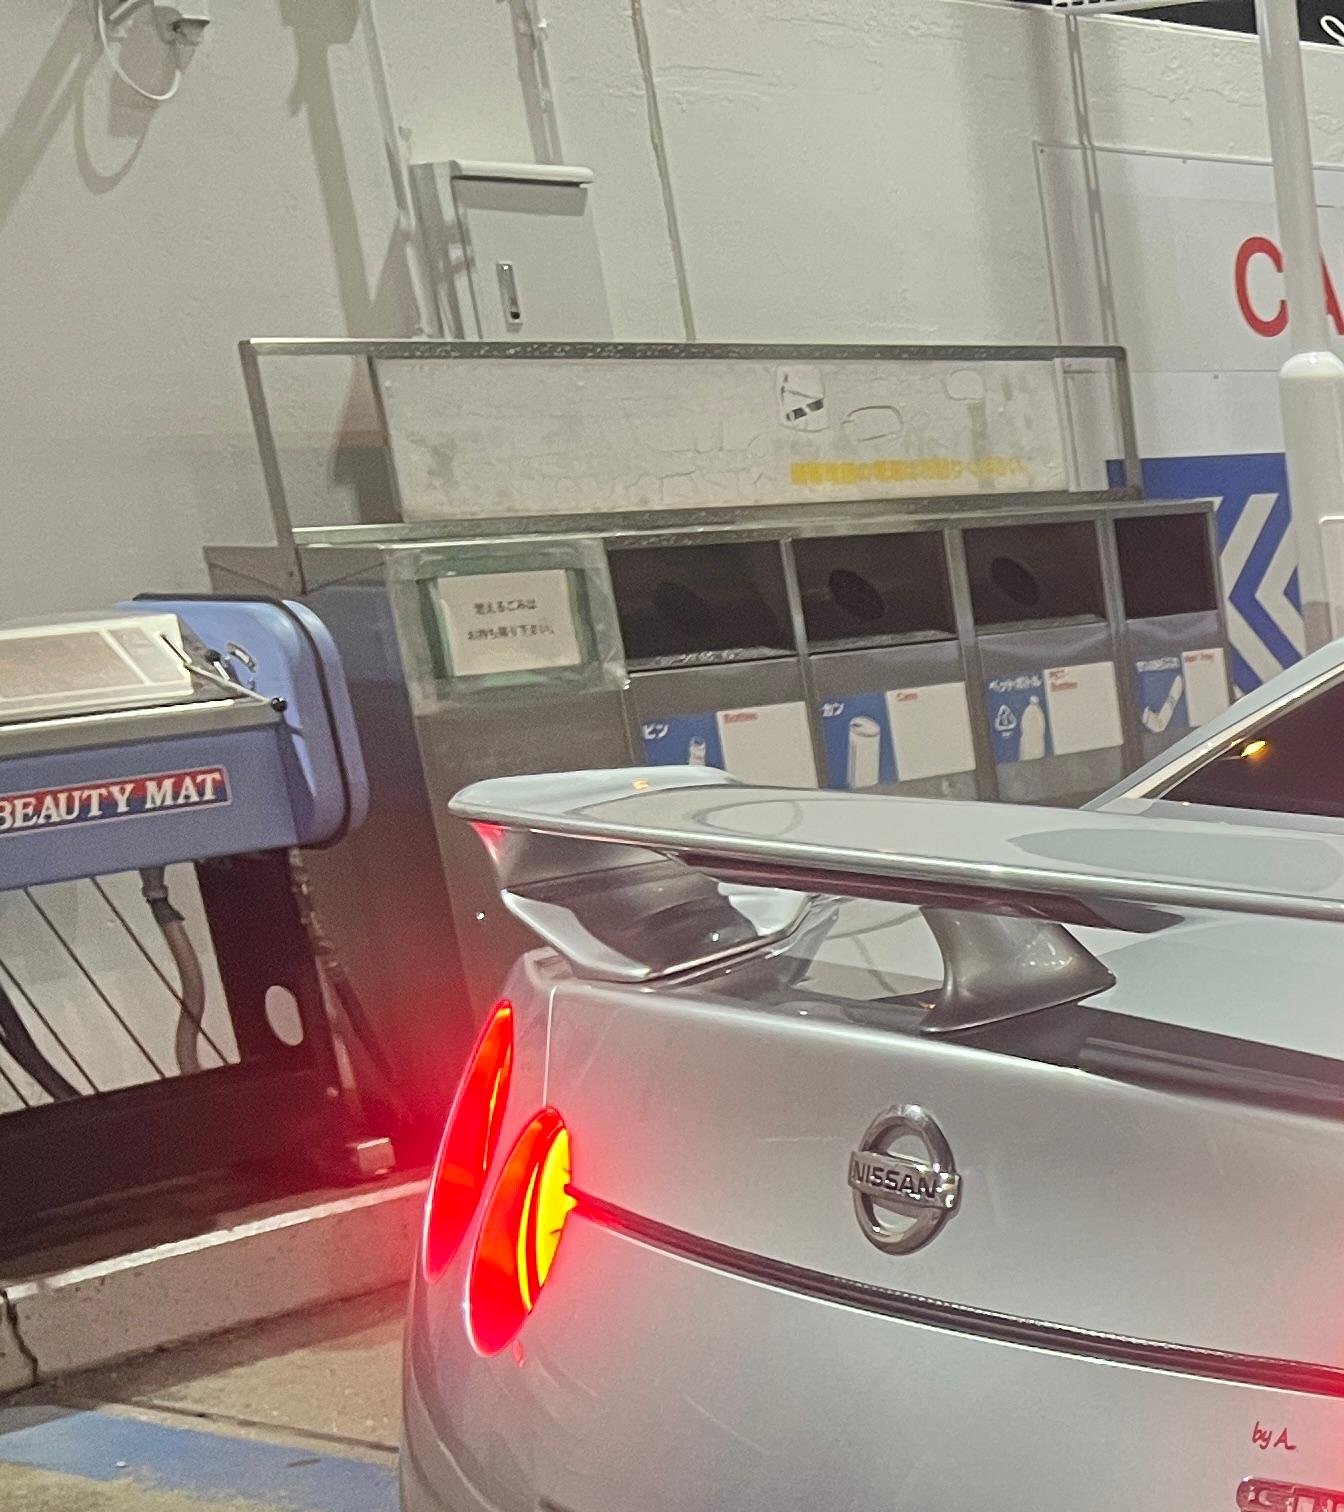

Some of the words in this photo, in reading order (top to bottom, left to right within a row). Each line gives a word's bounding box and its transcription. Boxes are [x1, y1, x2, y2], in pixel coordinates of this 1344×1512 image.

[0, 783, 136, 831] BEAUTY
[144, 772, 223, 810] MAT
[852, 1159, 938, 1199] NISSAN
